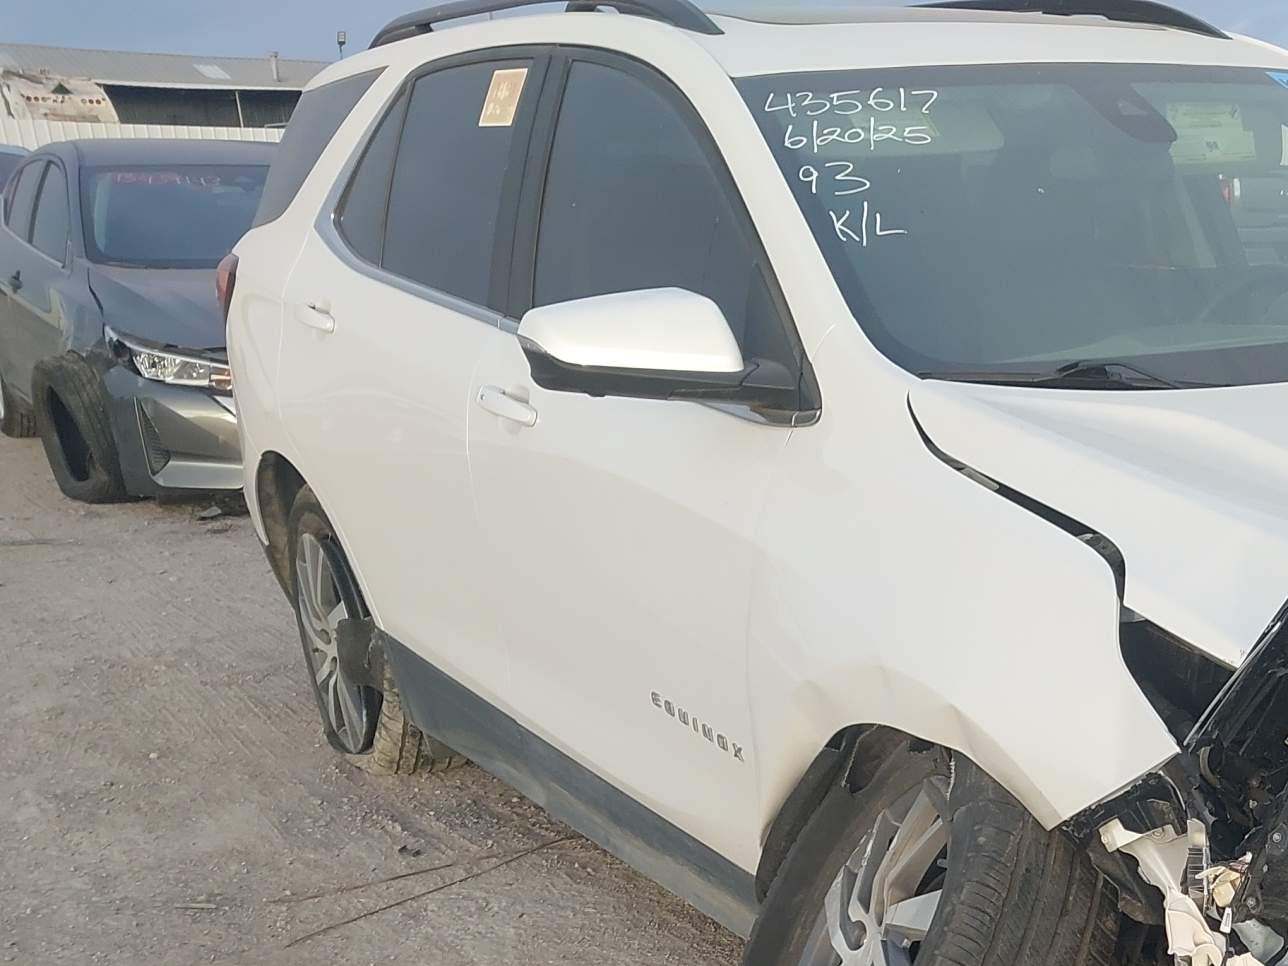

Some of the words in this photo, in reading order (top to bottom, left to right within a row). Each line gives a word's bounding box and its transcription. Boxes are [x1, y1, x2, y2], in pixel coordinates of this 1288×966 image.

[764, 88, 938, 117] 435617
[784, 117, 932, 152] 6/20/25
[650, 691, 745, 763] EQUINOX
